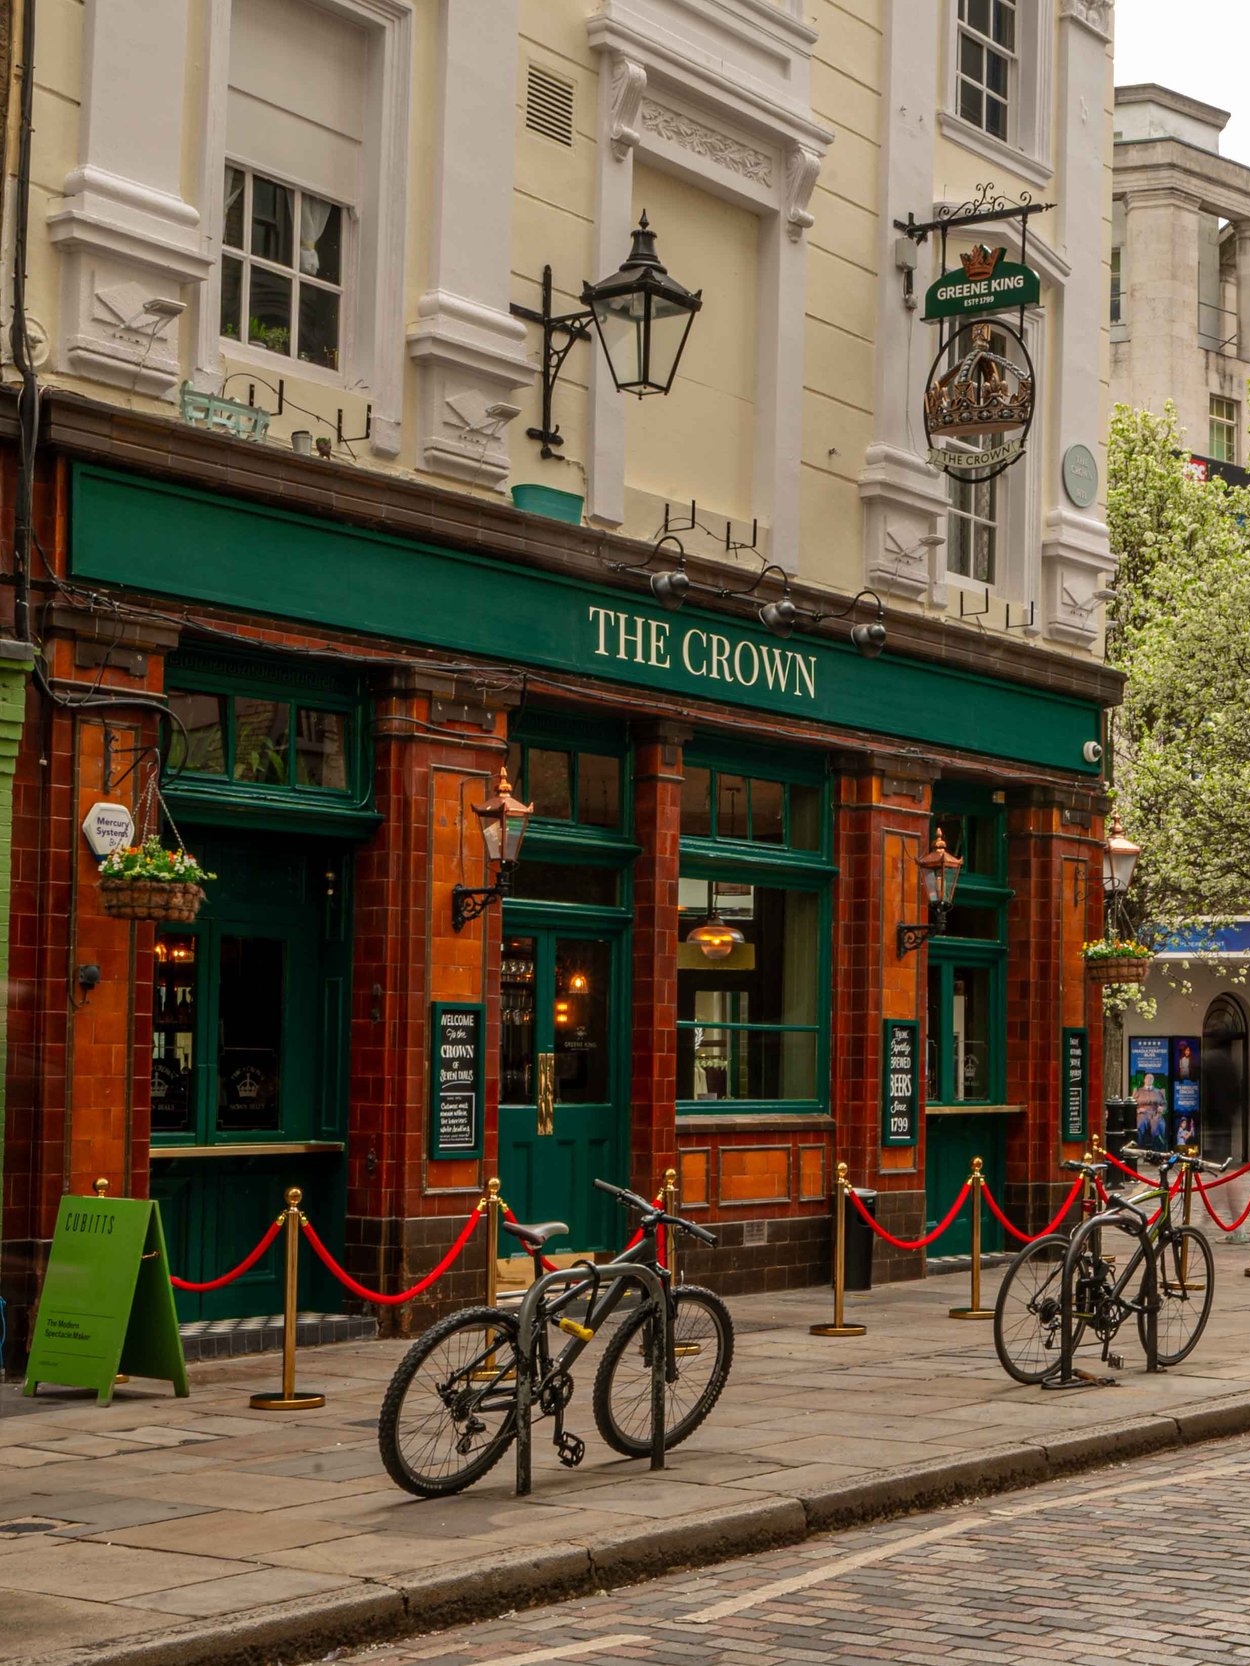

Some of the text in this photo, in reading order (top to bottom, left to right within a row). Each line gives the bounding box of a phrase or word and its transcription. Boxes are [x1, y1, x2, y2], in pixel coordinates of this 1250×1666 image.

[937, 275, 1025, 300] GREENE KING
[980, 295, 995, 305] 1799
[941, 443, 1011, 466] THE CROWN
[589, 606, 818, 700] THE CROWN
[96, 816, 130, 831] Mercury
[96, 826, 129, 838] Systems
[440, 1044, 474, 1059] CROWN
[890, 1074, 912, 1097] BEERS
[891, 1118, 908, 1132] 1799
[65, 1212, 116, 1236] CUBITTS
[47, 1318, 80, 1330] The Modern
[45, 1328, 91, 1341] Spectacle Maker
